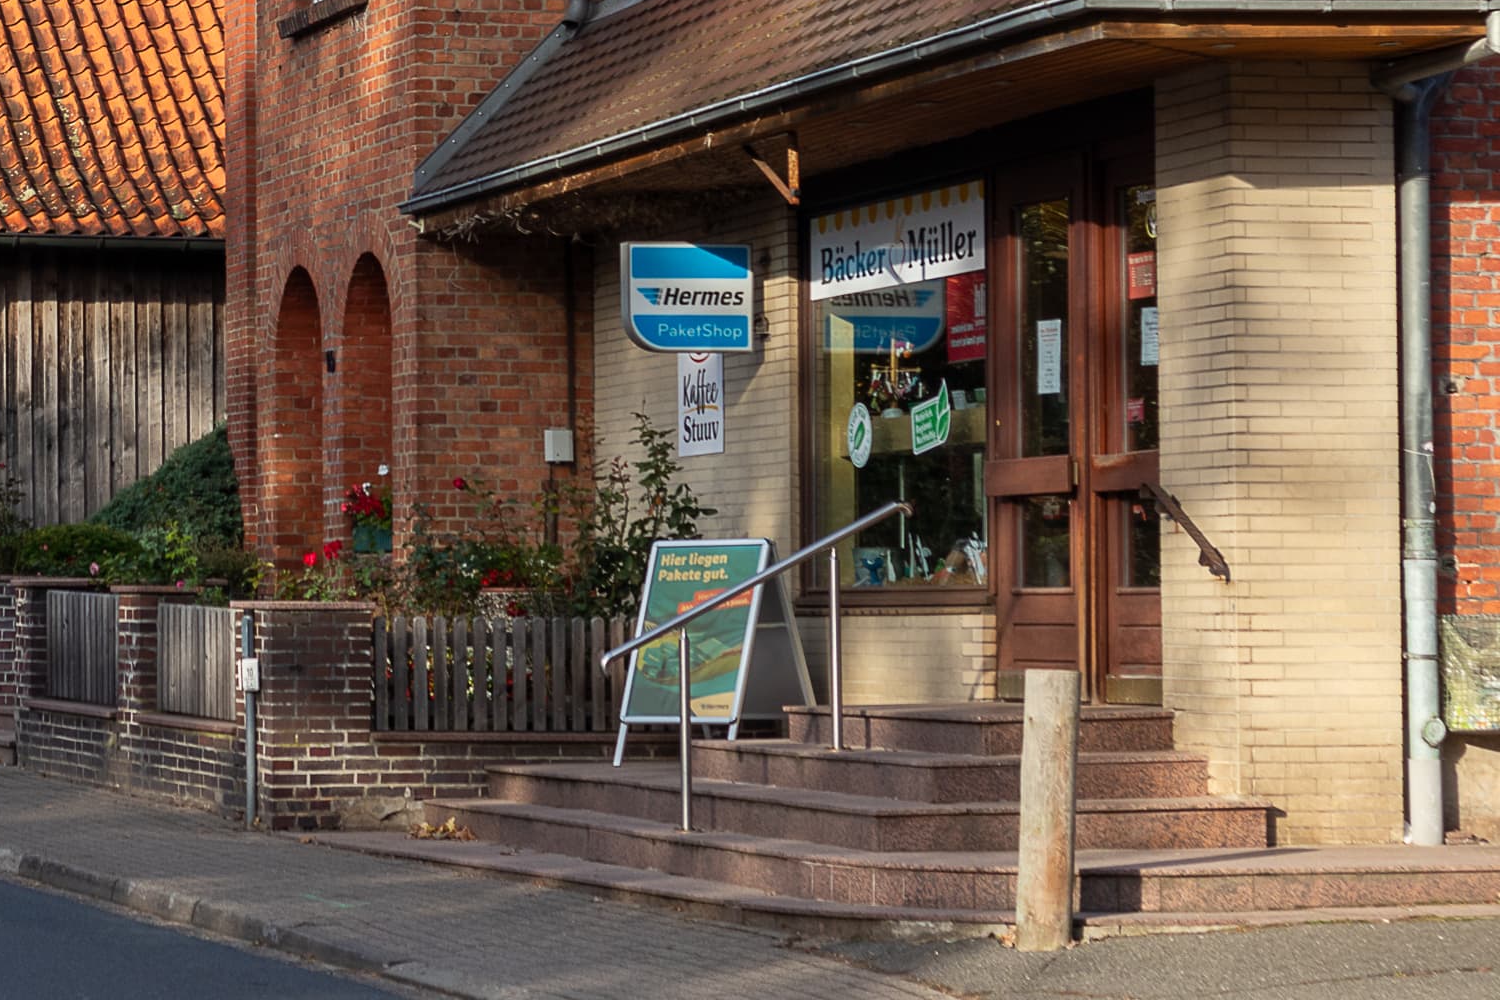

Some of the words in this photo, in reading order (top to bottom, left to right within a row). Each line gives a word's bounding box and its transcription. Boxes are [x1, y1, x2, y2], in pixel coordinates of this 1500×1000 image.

[820, 240, 886, 285] Bäcker
[907, 221, 977, 269] Müller
[664, 287, 744, 306] Hermes
[658, 324, 743, 345] PaketShop
[683, 369, 719, 415] Kaffee
[683, 416, 719, 444] Stuuv
[661, 553, 687, 567] Hier
[688, 553, 728, 568] liegen
[658, 569, 701, 582] Pakete
[703, 568, 729, 583] gut.
